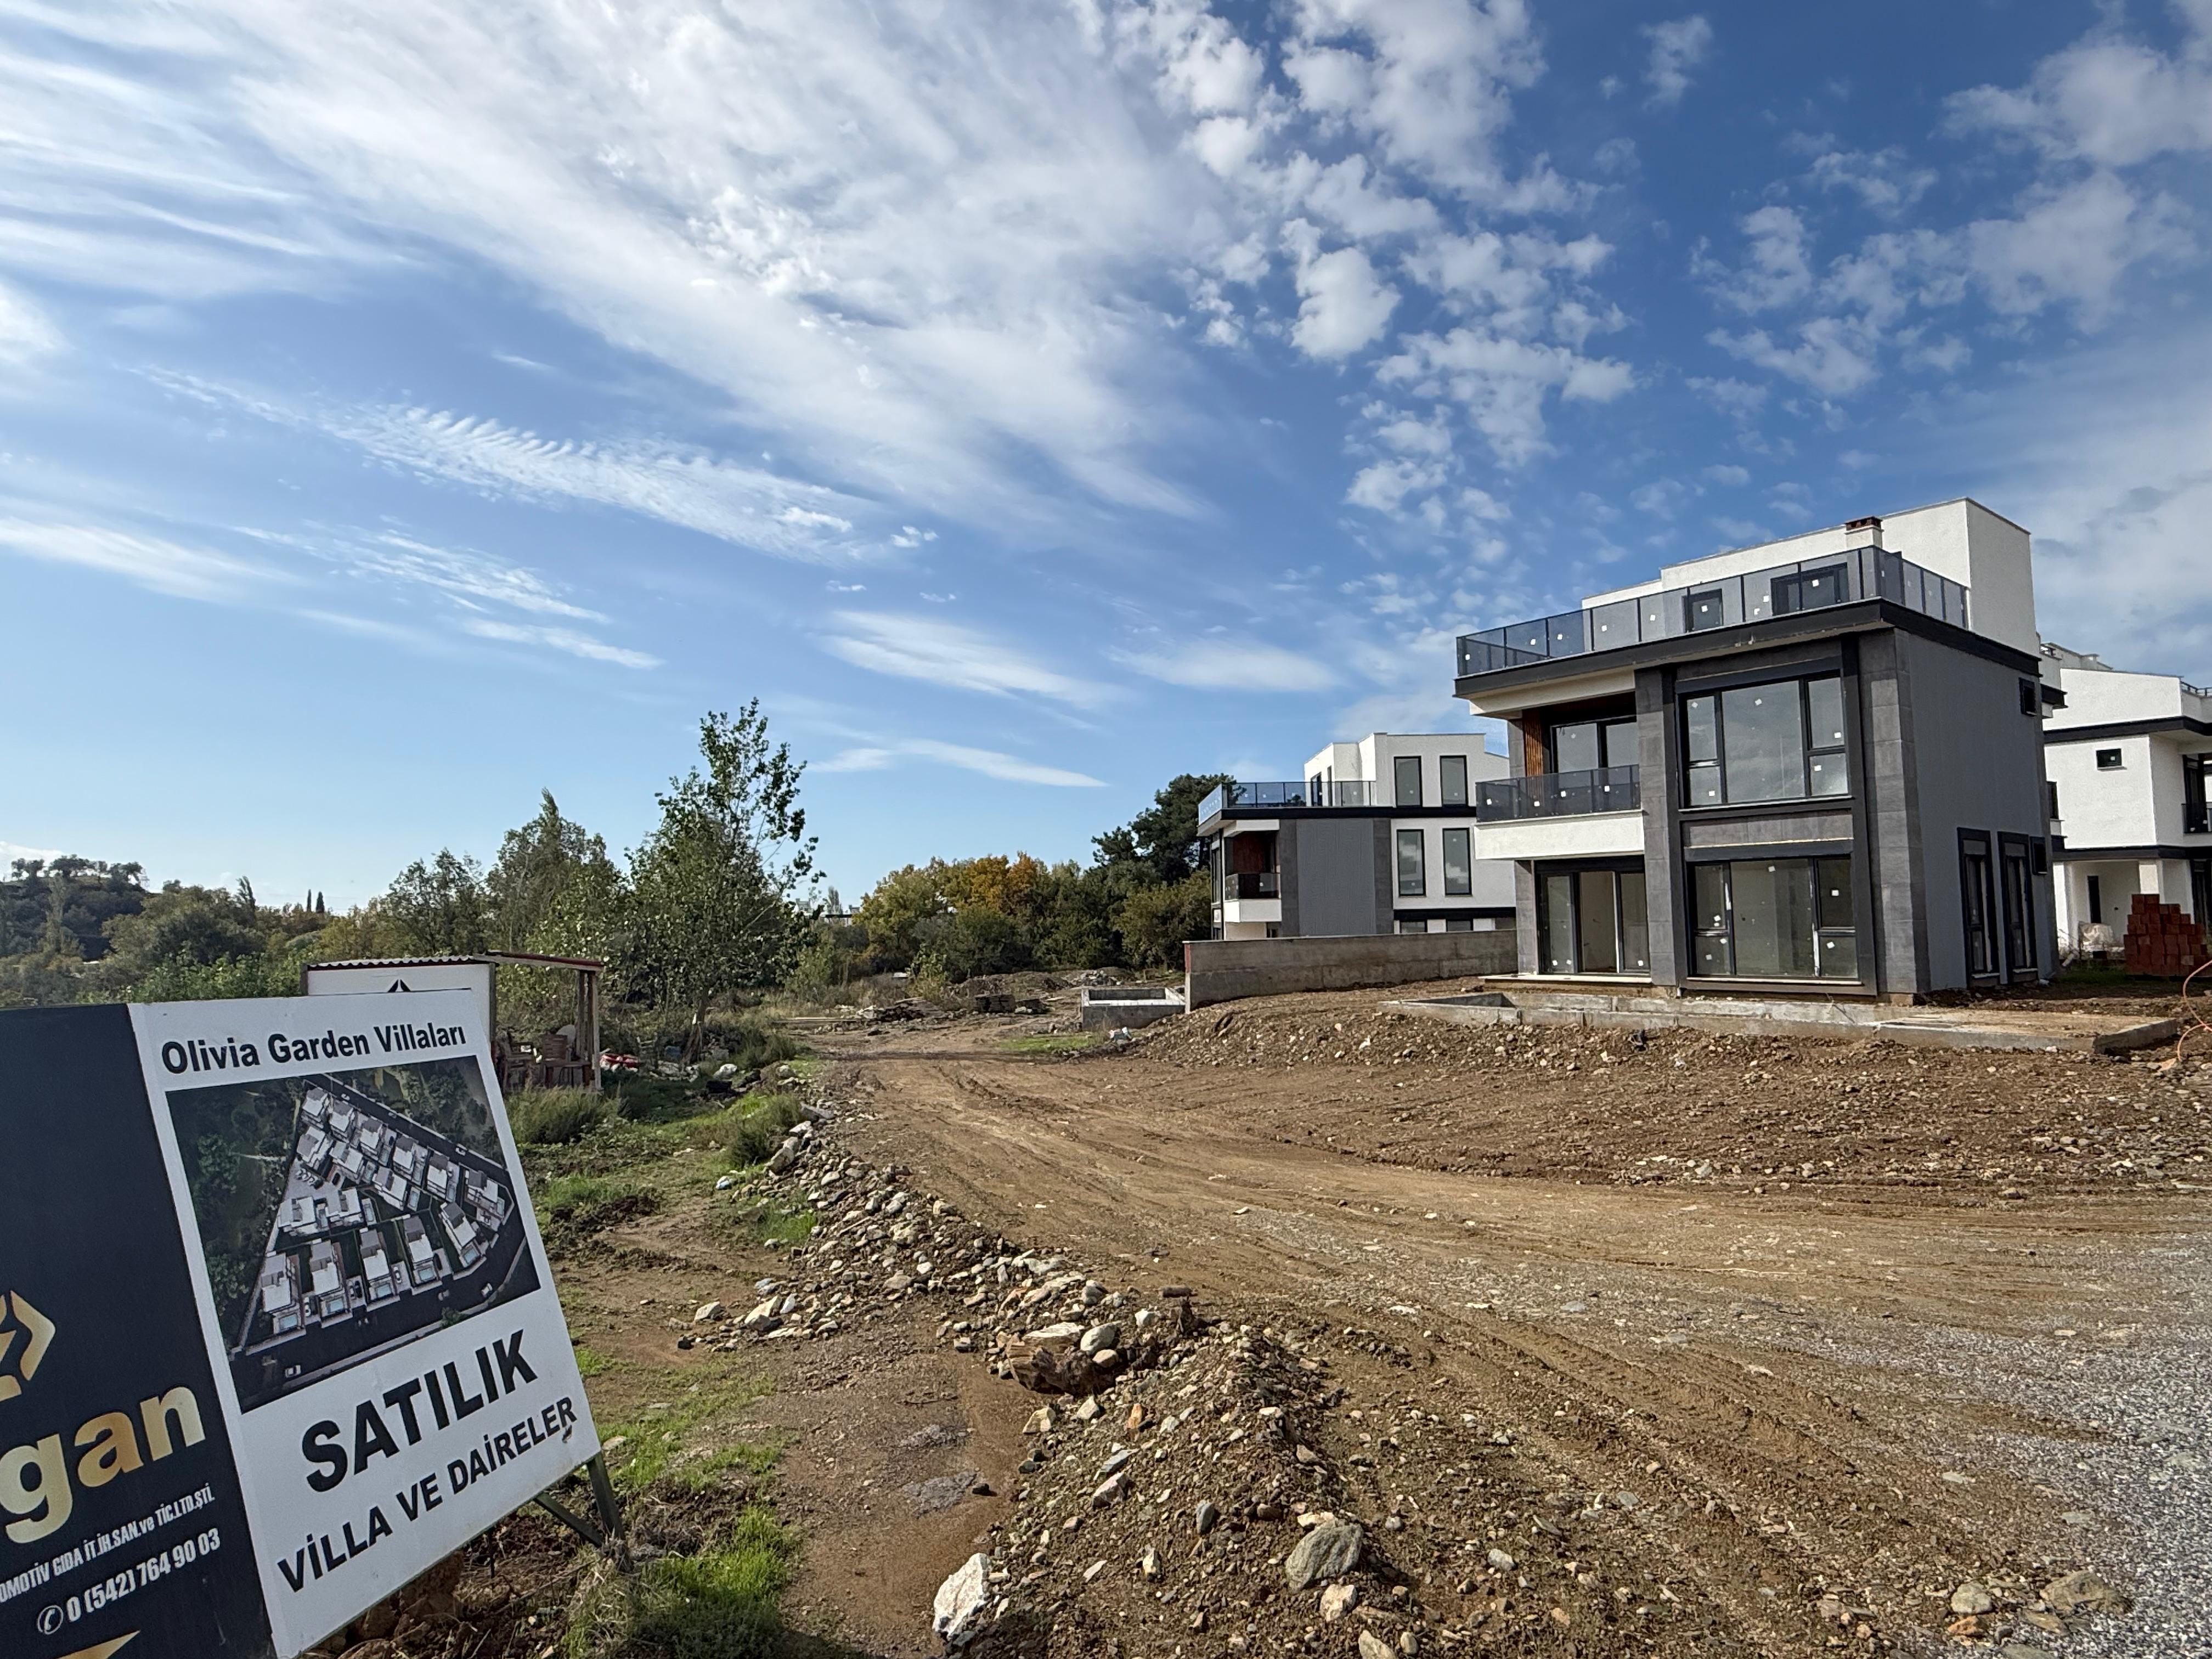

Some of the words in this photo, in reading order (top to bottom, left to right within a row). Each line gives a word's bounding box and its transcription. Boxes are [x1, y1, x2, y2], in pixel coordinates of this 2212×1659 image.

[162, 1037, 260, 1074] Olivia
[268, 1030, 370, 1063] Garden
[374, 1023, 466, 1052] Villaları
[302, 1329, 538, 1493] SATILIK
[277, 1505, 393, 1593] VİLLA
[396, 1473, 443, 1521] VE
[447, 1396, 578, 1495] DAİRELER
[53, 1548, 84, 1576] GIDA
[66, 1596, 81, 1622] 0
[84, 1569, 137, 1613] (542)
[137, 1551, 171, 1587] 764
[172, 1540, 196, 1568] 90
[198, 1527, 221, 1556] 03
